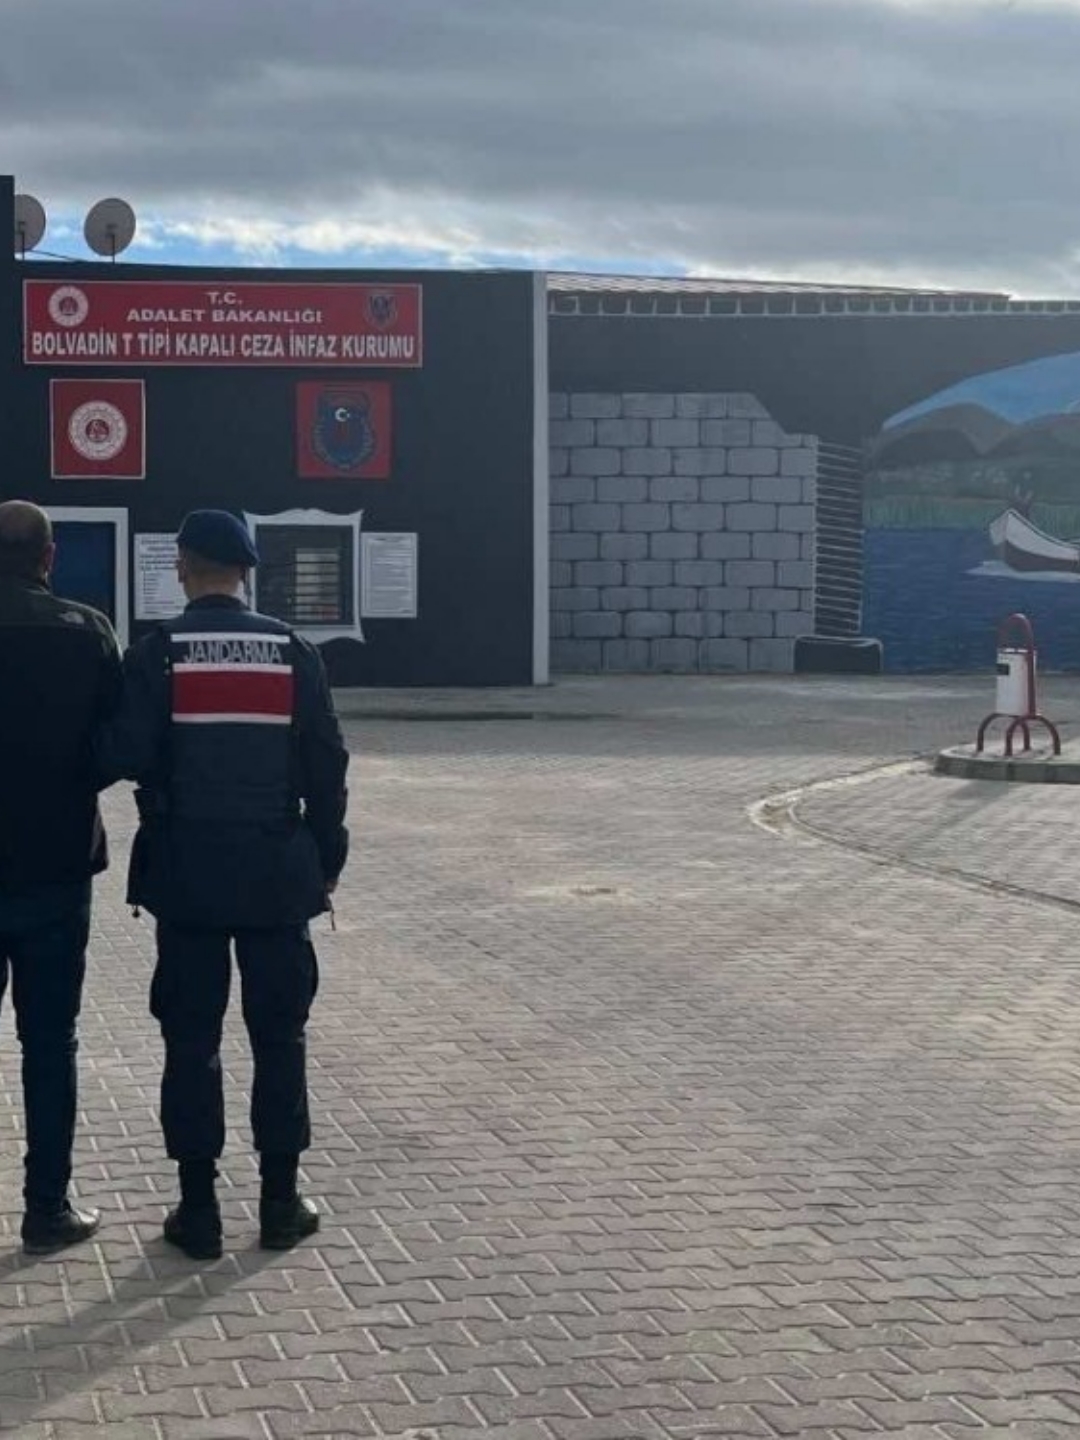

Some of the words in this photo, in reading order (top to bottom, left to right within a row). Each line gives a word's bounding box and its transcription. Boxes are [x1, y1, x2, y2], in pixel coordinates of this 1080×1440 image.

[207, 291, 243, 305] T.C.
[127, 308, 206, 322] ADALET
[212, 307, 322, 323] BAKANLIĞI
[32, 327, 117, 356] BOLVADİN
[122, 333, 134, 356] T
[138, 328, 170, 357] TİPİ
[175, 333, 235, 357] KAPALI
[241, 333, 285, 358] CEZA
[289, 328, 338, 358] İNFAZ
[341, 334, 415, 359] KURUMU
[183, 640, 283, 664] JANDARMA
